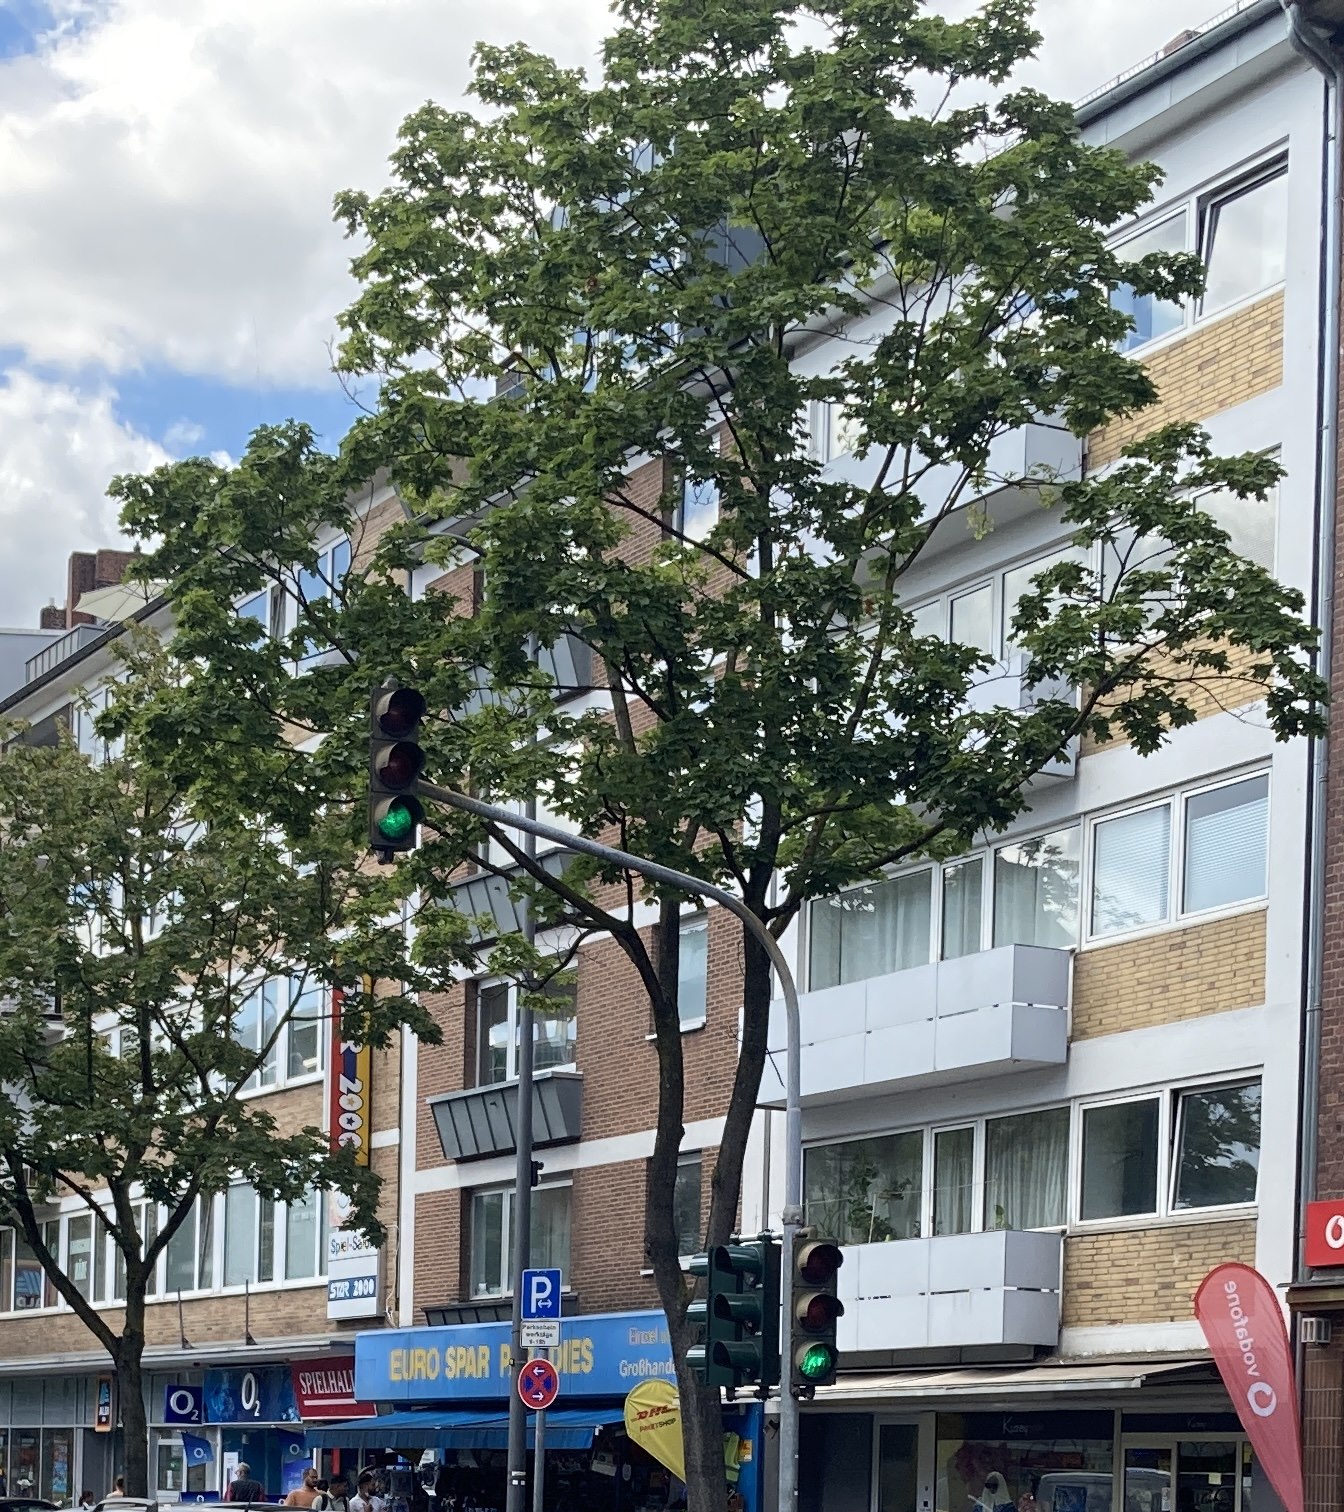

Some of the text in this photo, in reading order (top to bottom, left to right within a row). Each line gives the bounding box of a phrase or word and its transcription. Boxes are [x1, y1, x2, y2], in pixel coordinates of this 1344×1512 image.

[331, 1236, 372, 1255] Spiel-Salo
[389, 1337, 594, 1381] EURO SPAR PDIES
